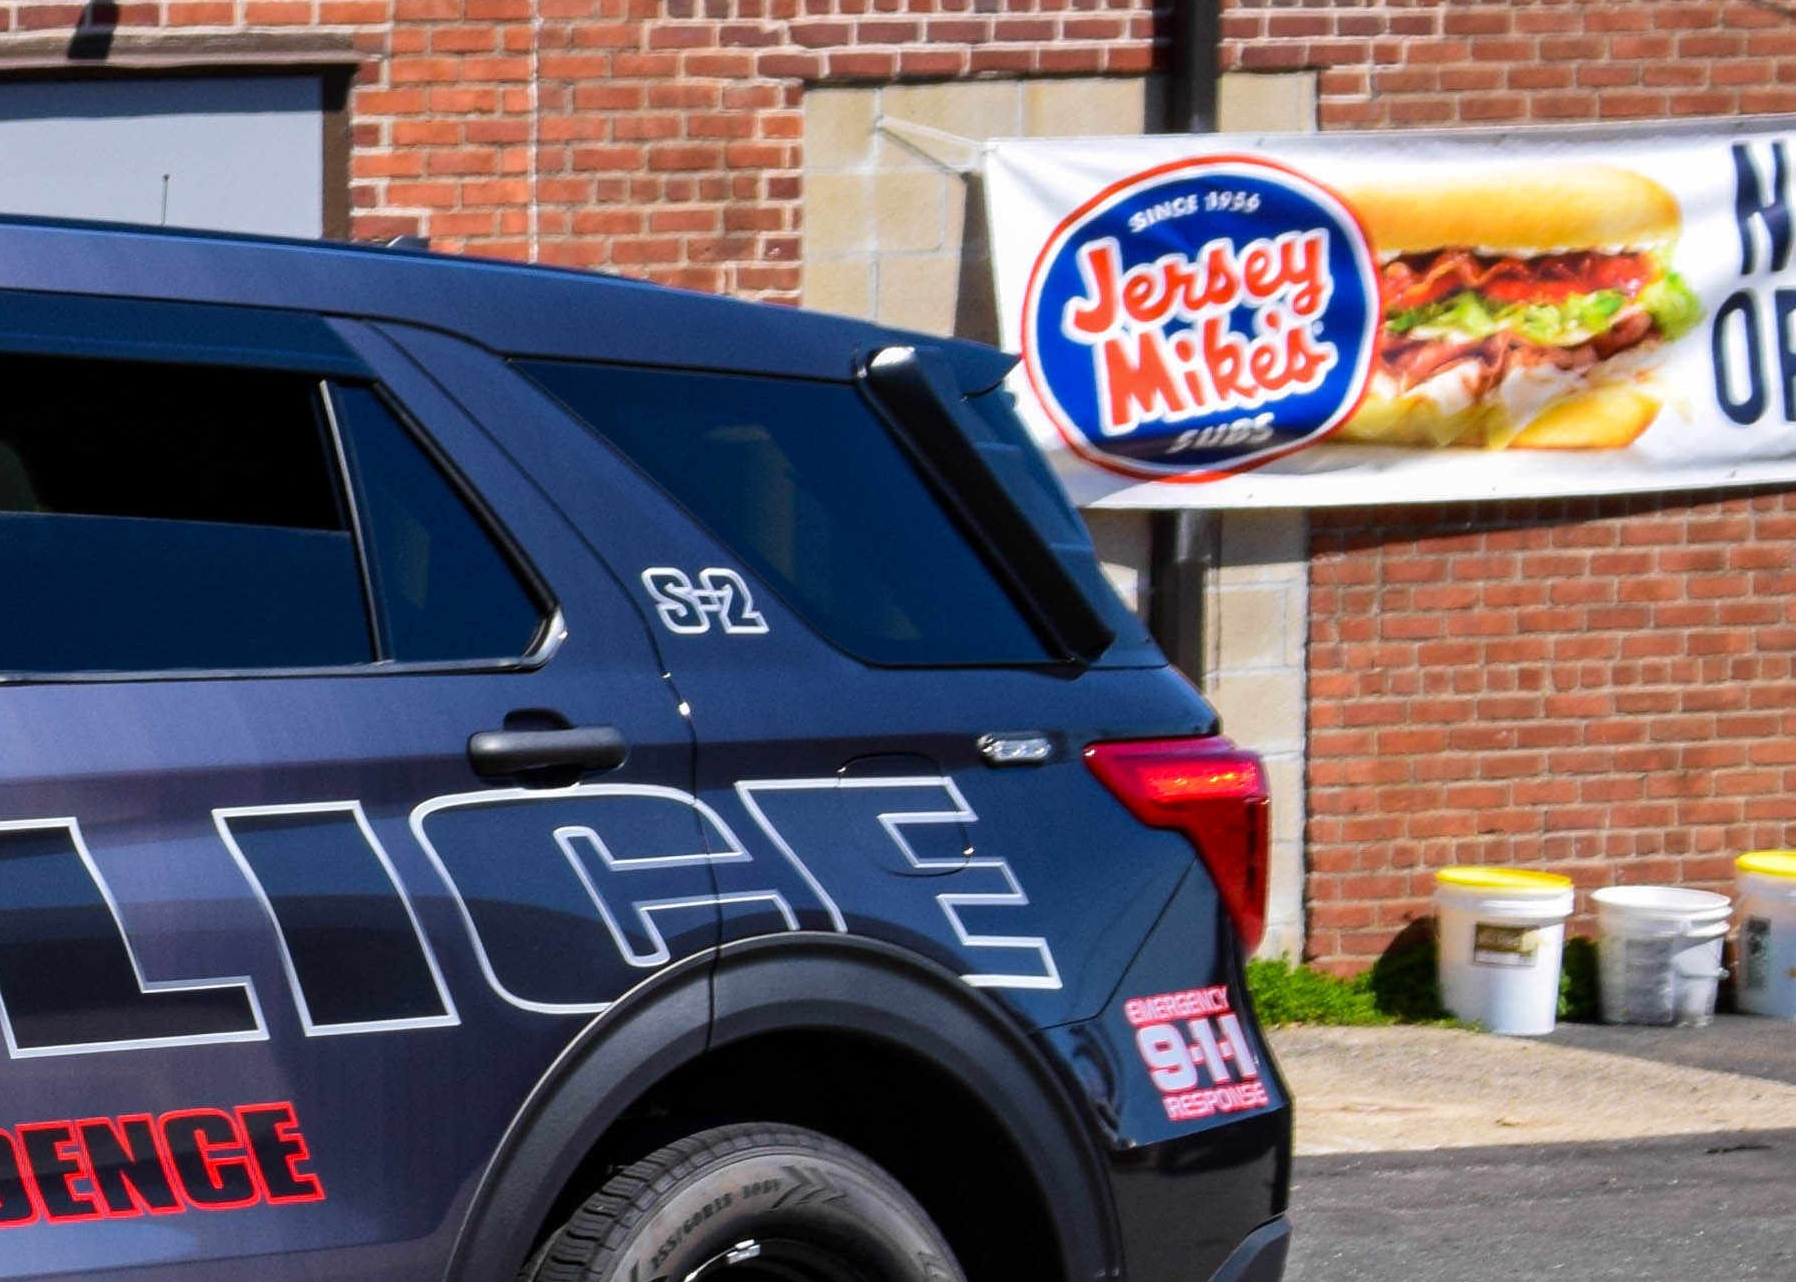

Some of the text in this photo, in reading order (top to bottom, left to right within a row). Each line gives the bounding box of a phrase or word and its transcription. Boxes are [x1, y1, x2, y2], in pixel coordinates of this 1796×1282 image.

[1127, 190, 1261, 233] SINCE 1956
[1065, 230, 1332, 341] Jersey
[1097, 309, 1335, 433] Mike's
[1165, 412, 1276, 453] SUBS
[641, 567, 769, 634] S-2
[1125, 984, 1230, 1027] EMERGENCY
[1136, 1012, 1257, 1093] 9-1-1
[1162, 1081, 1270, 1122] RESPONSE
